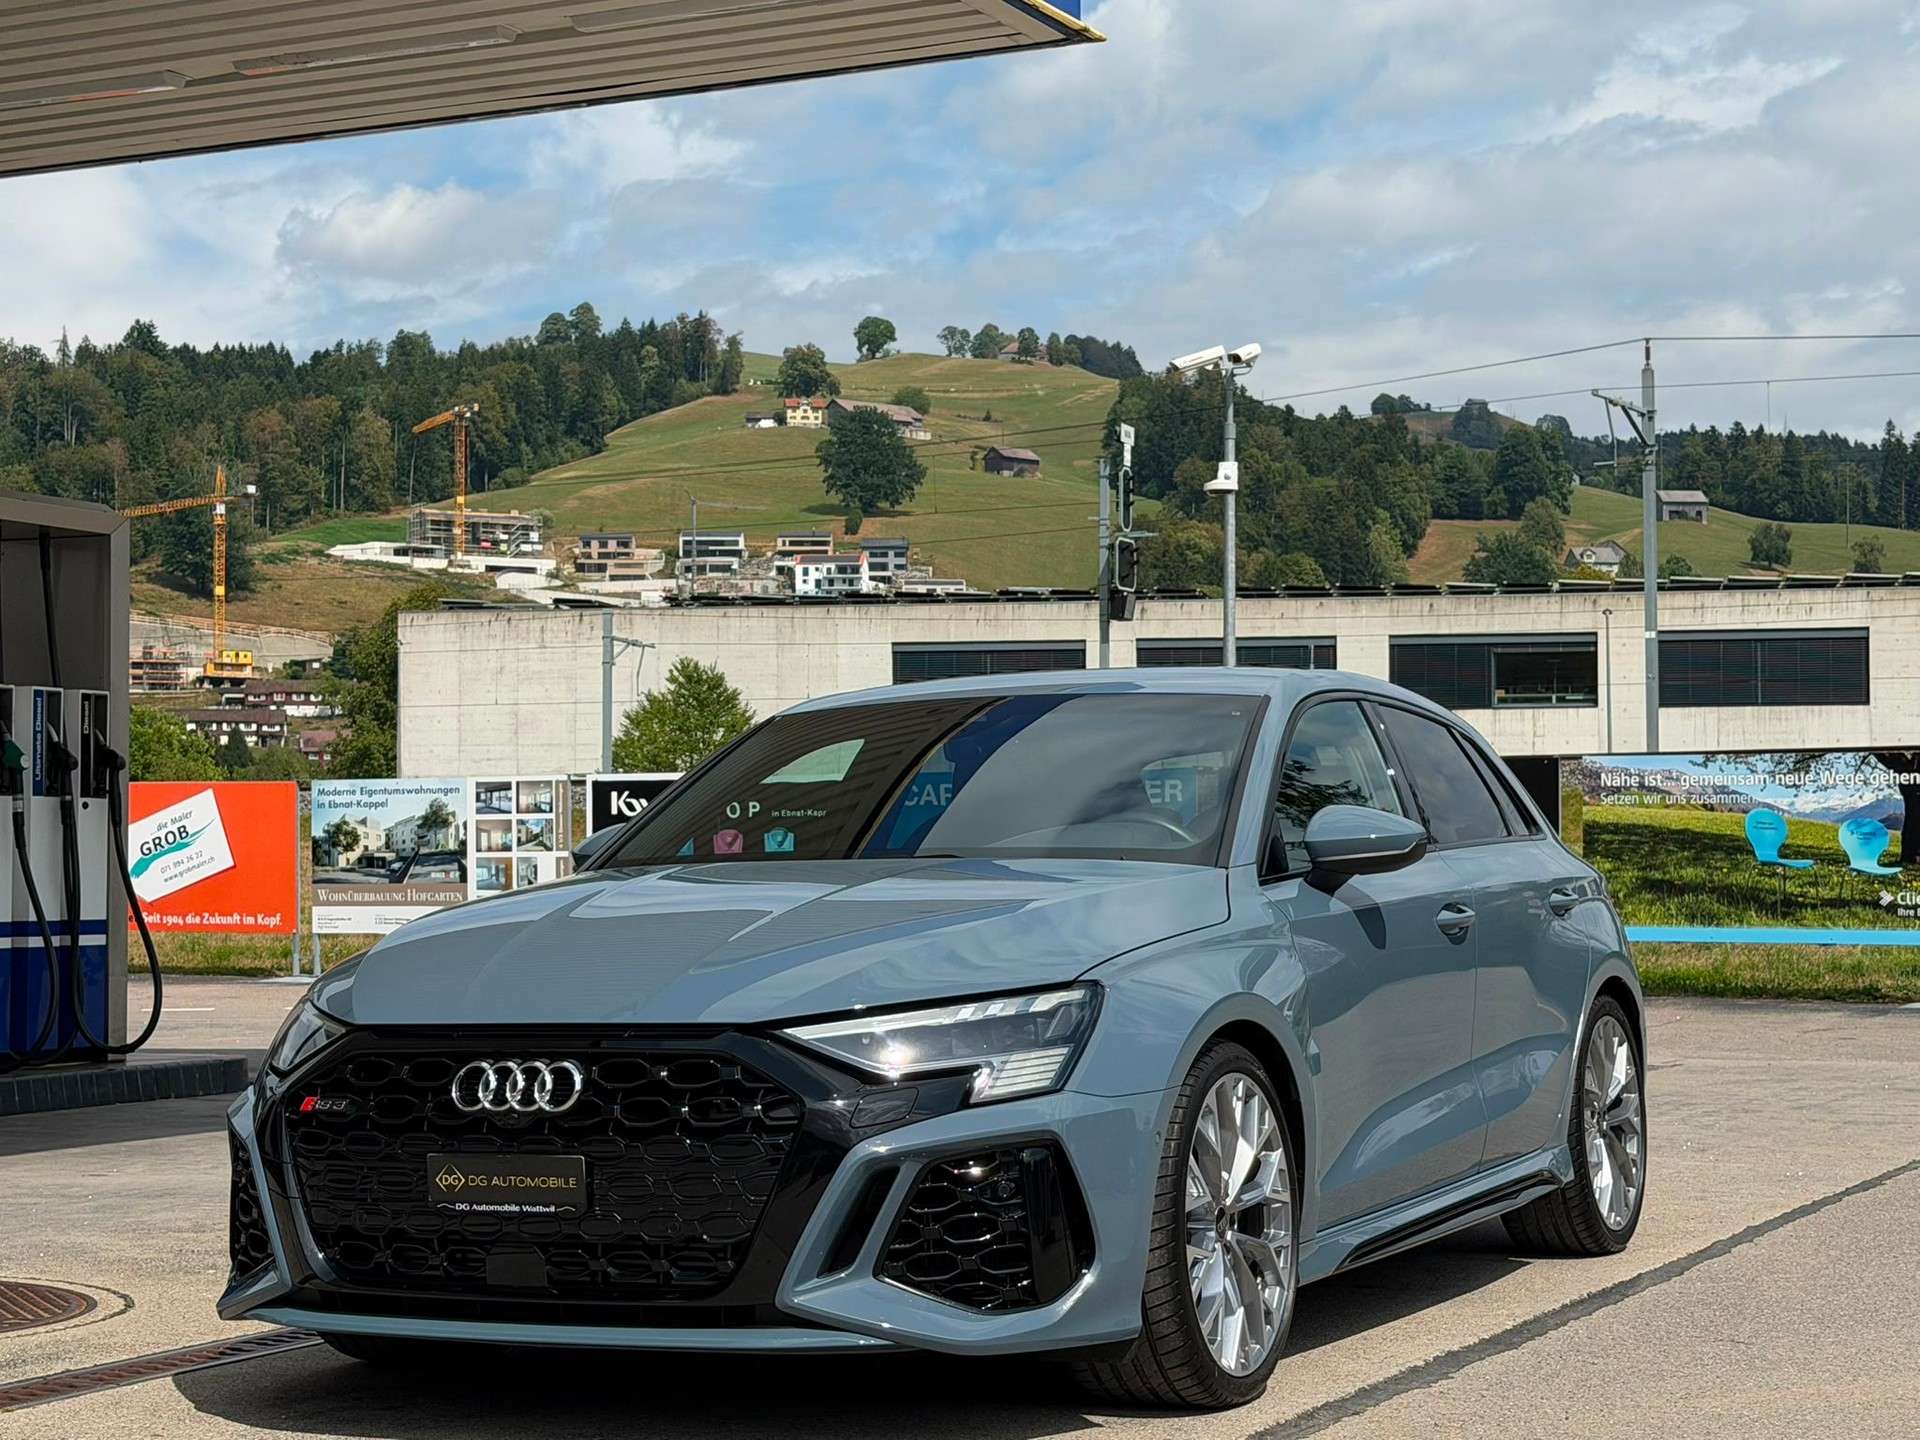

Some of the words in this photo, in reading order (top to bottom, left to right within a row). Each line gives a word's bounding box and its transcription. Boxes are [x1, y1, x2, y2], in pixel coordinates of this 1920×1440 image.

[1600, 772, 1639, 787] Nähe
[1681, 773, 1769, 789] gemeinsam
[1775, 773, 1817, 785] neue
[1820, 771, 1868, 788] Wege
[317, 787, 357, 797] Moderne
[360, 785, 460, 798] Eigentumswohnungen
[317, 800, 326, 809] in
[328, 798, 389, 810] Ebnat-Kappel
[1600, 793, 1639, 805] Setzen
[1643, 793, 1661, 805] wir
[1666, 794, 1687, 805] uns
[1690, 794, 1759, 805] zusammen.
[156, 822, 169, 832] die
[170, 810, 193, 826] Maler
[139, 824, 190, 857] GROB
[1897, 907, 1915, 917] Ihre
[142, 911, 161, 923] Seit
[162, 914, 184, 926] 1904
[185, 912, 201, 924] die
[202, 912, 241, 925] Zukunft
[243, 913, 256, 925] im
[257, 913, 283, 929] Kopf.
[442, 1174, 459, 1186] DG
[468, 1175, 488, 1187] DG
[491, 1175, 577, 1188] AUTOMOBILE
[455, 1203, 470, 1211] DG
[471, 1203, 521, 1212] Automobile
[522, 1204, 556, 1213] Wattwil
